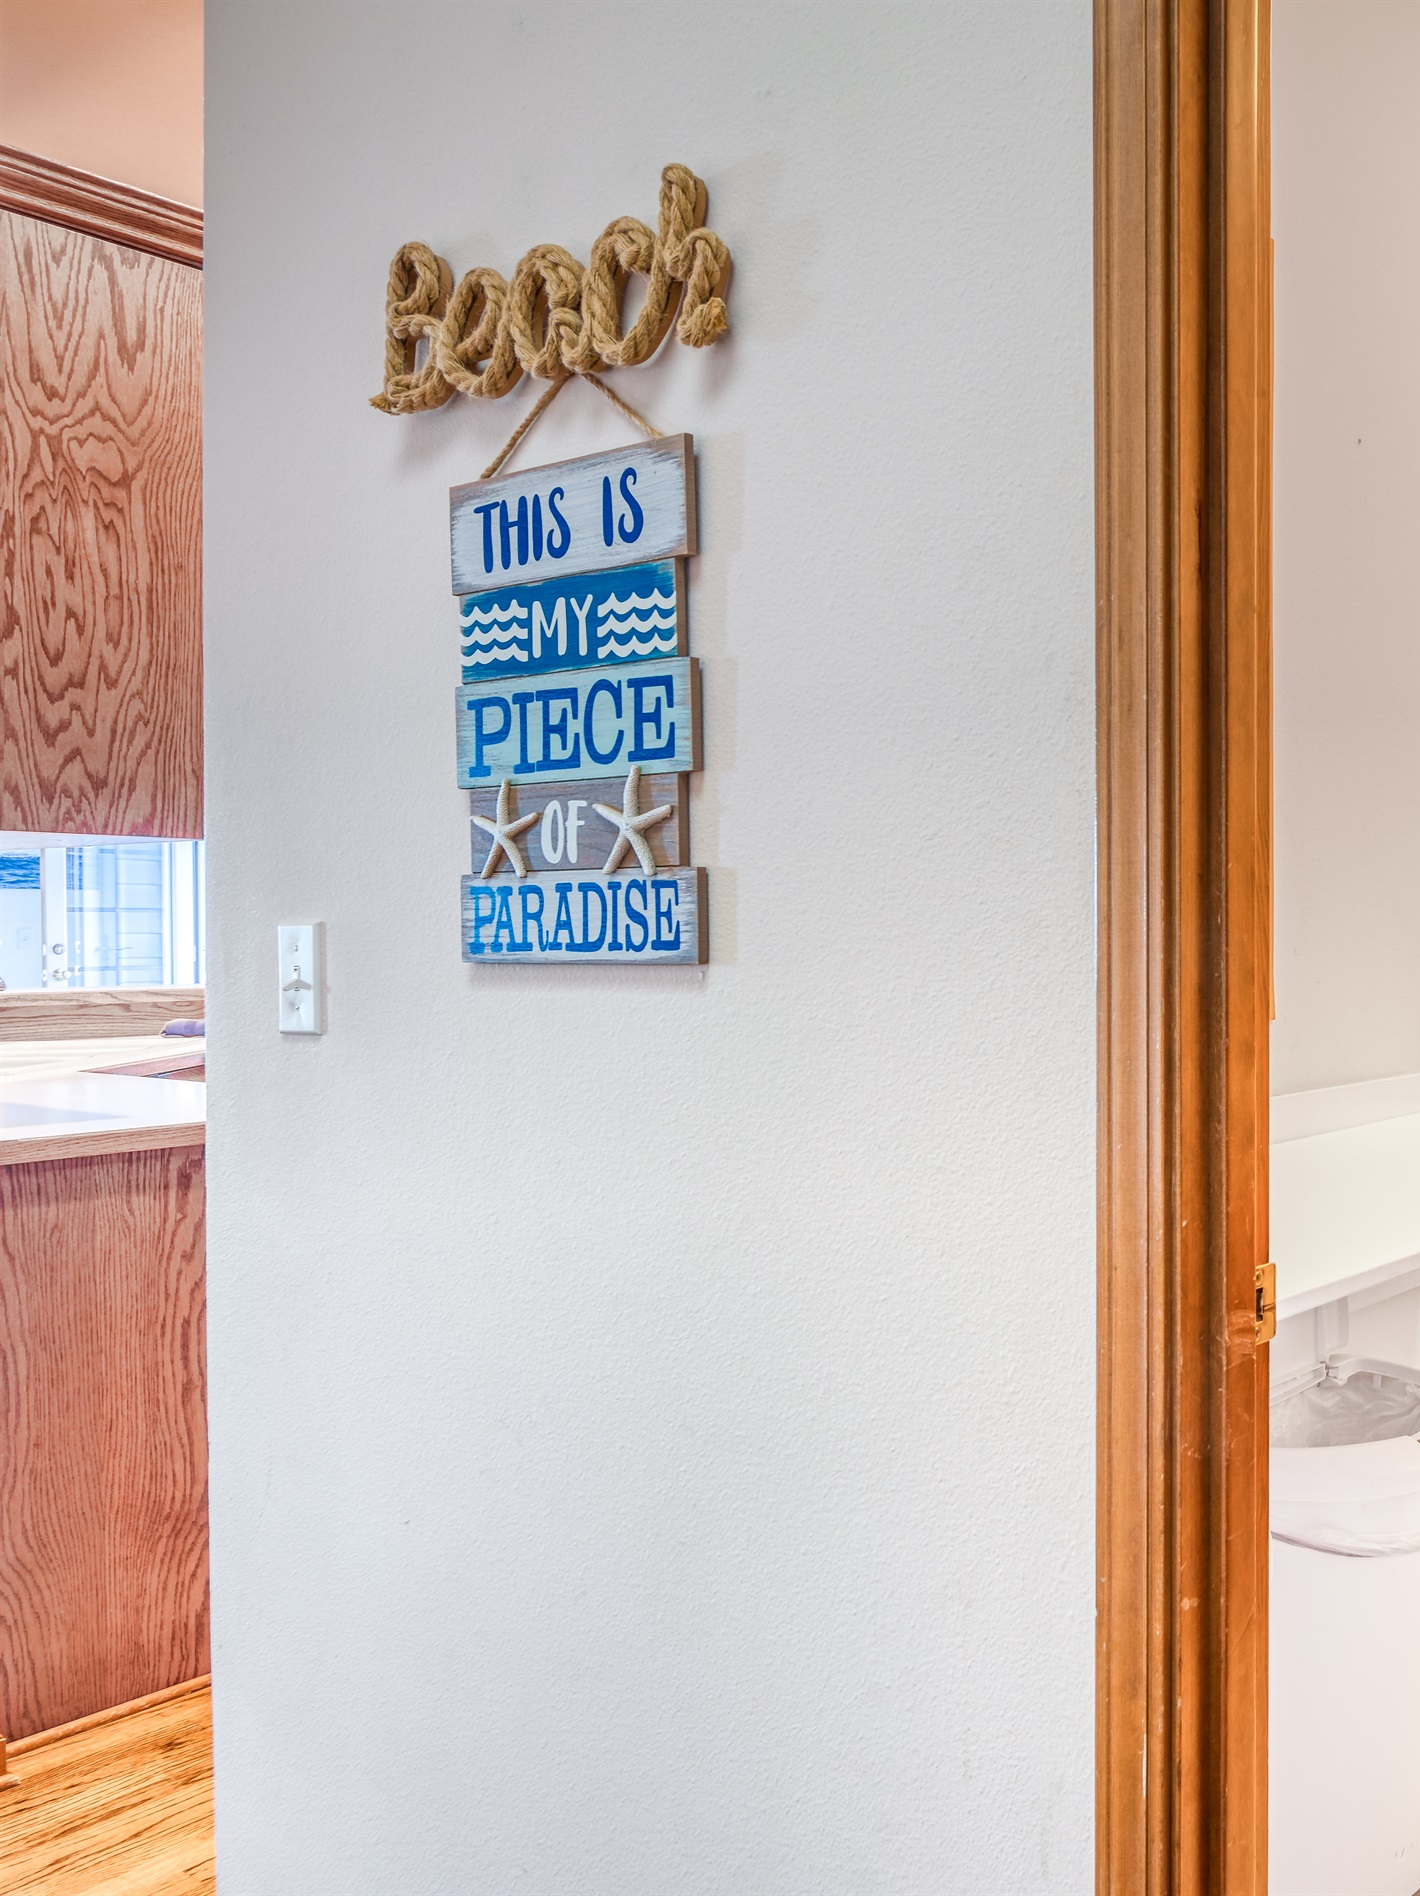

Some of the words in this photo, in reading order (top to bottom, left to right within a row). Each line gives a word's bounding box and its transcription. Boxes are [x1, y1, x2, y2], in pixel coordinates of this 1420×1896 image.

[368, 162, 732, 416] Beach
[474, 486, 572, 574] THIS
[602, 466, 644, 548] IS
[532, 592, 594, 658] MY
[466, 674, 676, 778] PIECE
[540, 799, 588, 864] OF
[468, 880, 681, 955] PARADISE
